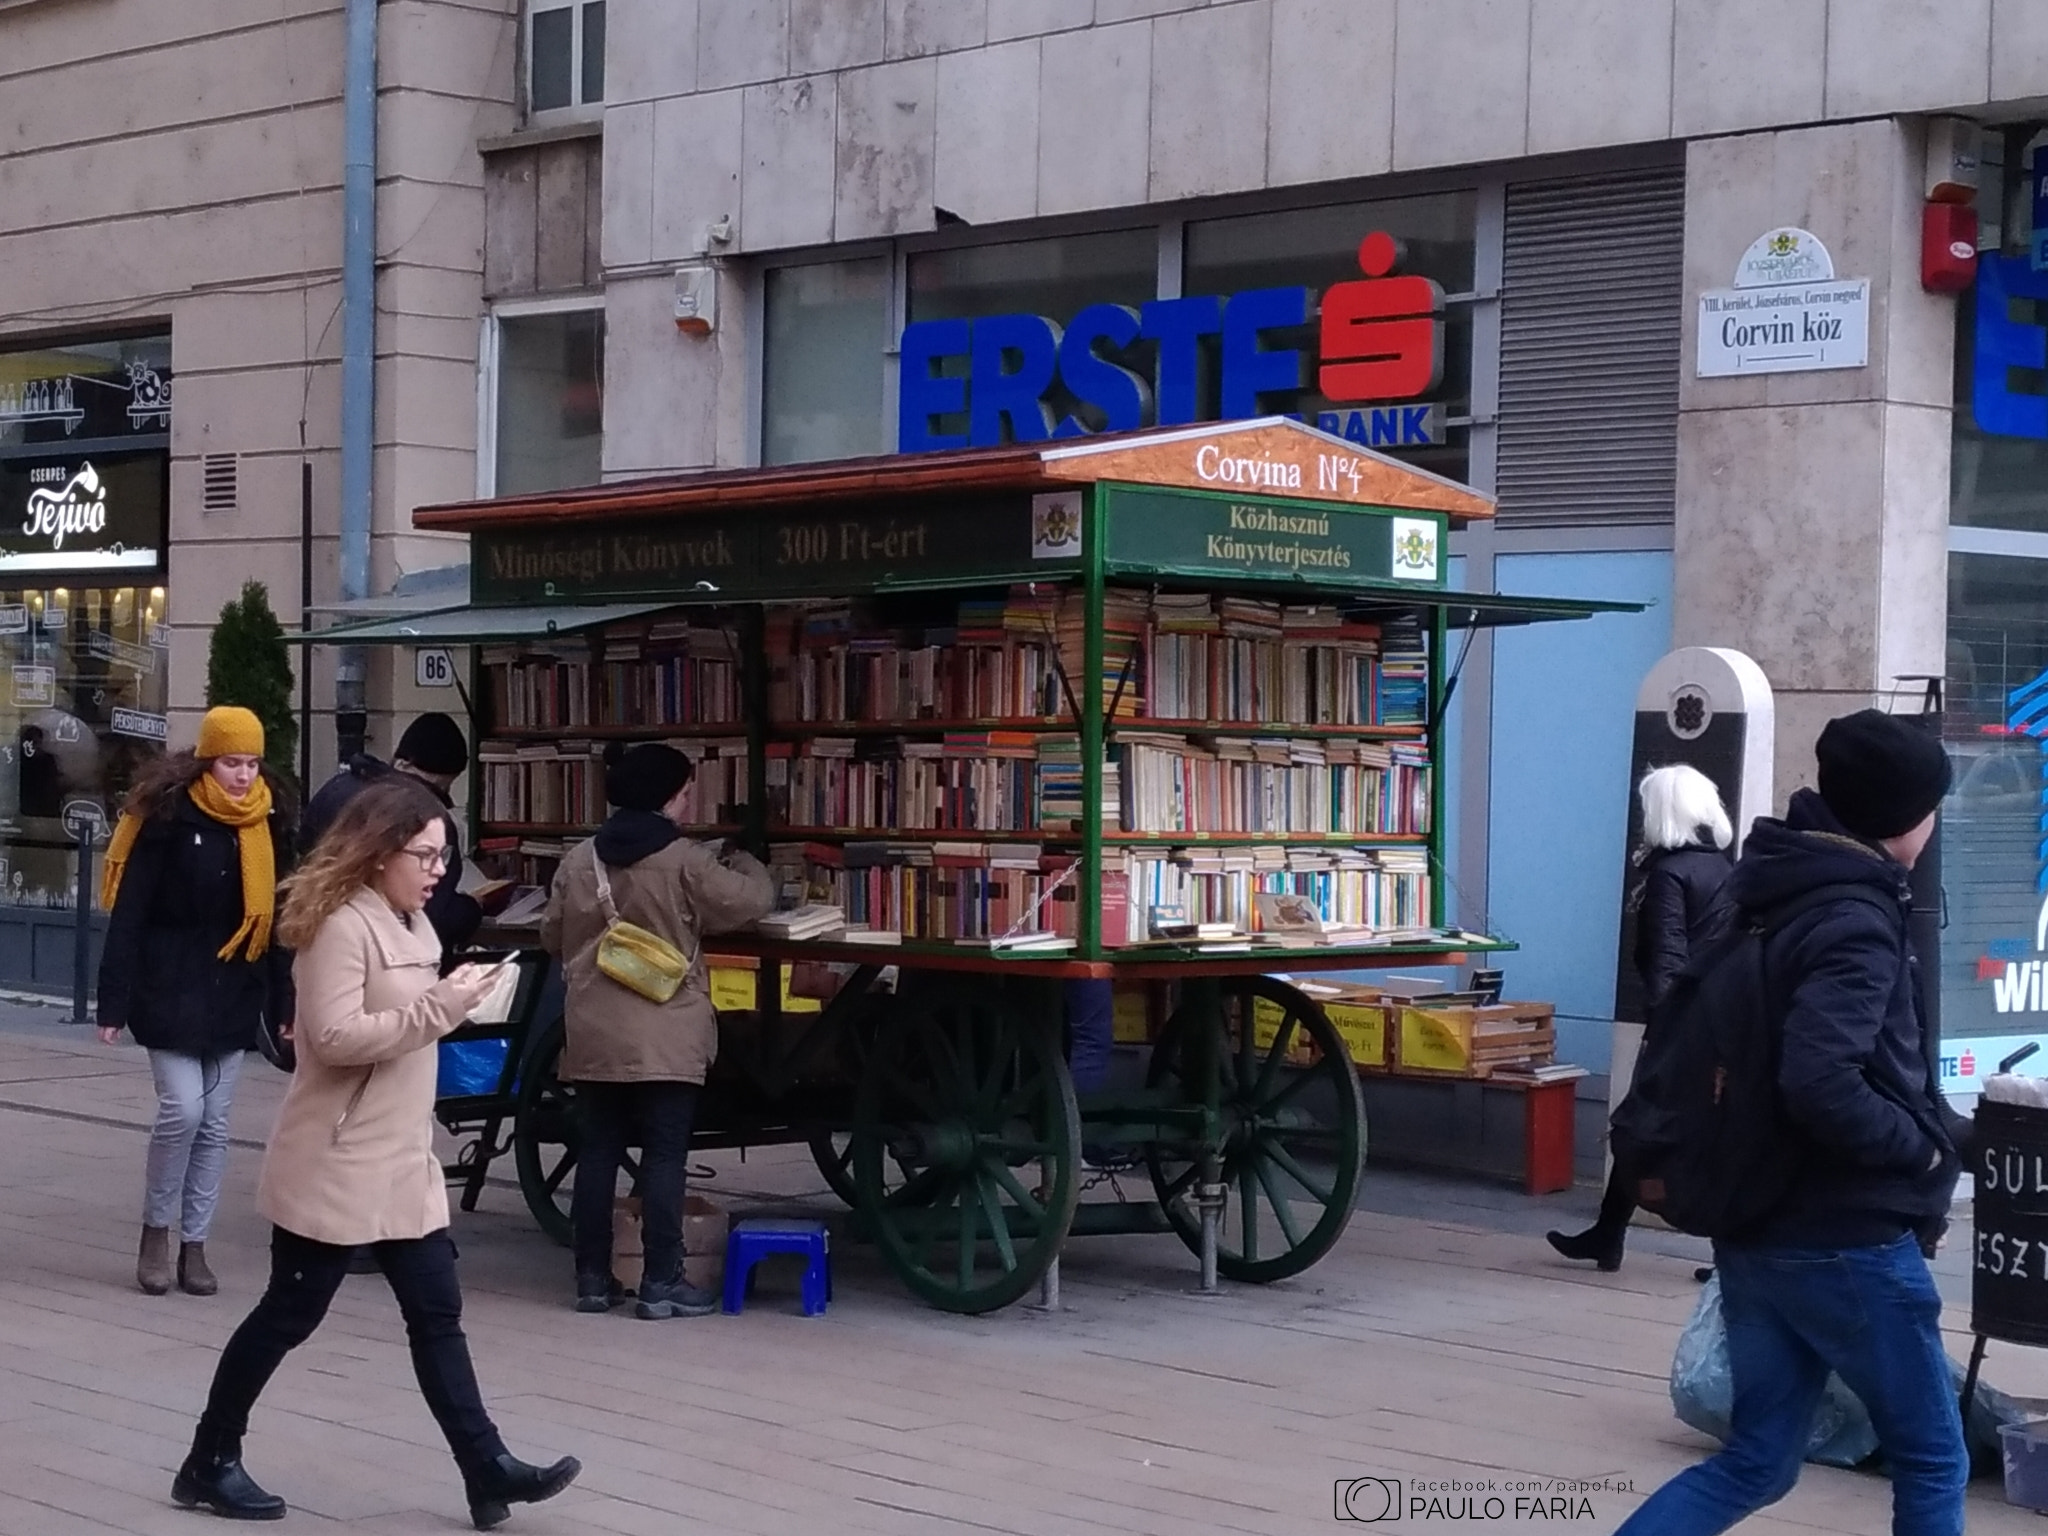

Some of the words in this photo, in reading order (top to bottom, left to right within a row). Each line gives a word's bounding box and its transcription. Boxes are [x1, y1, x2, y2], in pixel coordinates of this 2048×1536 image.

[1805, 290, 1831, 305] Corvin
[1833, 286, 1862, 304] negyed
[1722, 314, 1794, 348] Corvin
[1802, 311, 1843, 342] köz
[899, 286, 1308, 454] ERSTE
[1318, 405, 1432, 447] BANK
[30, 466, 66, 483] CSERPES
[1196, 444, 1301, 488] Corvina
[23, 486, 106, 550] Tejivó
[1230, 505, 1329, 536] Közhasznú
[490, 537, 604, 582] Minőségi
[611, 529, 734, 579] Könyvek
[776, 524, 828, 567] 300
[838, 519, 928, 562] Ft-ért
[1207, 534, 1351, 571] Könyvterjesztés
[426, 655, 446, 679] 86
